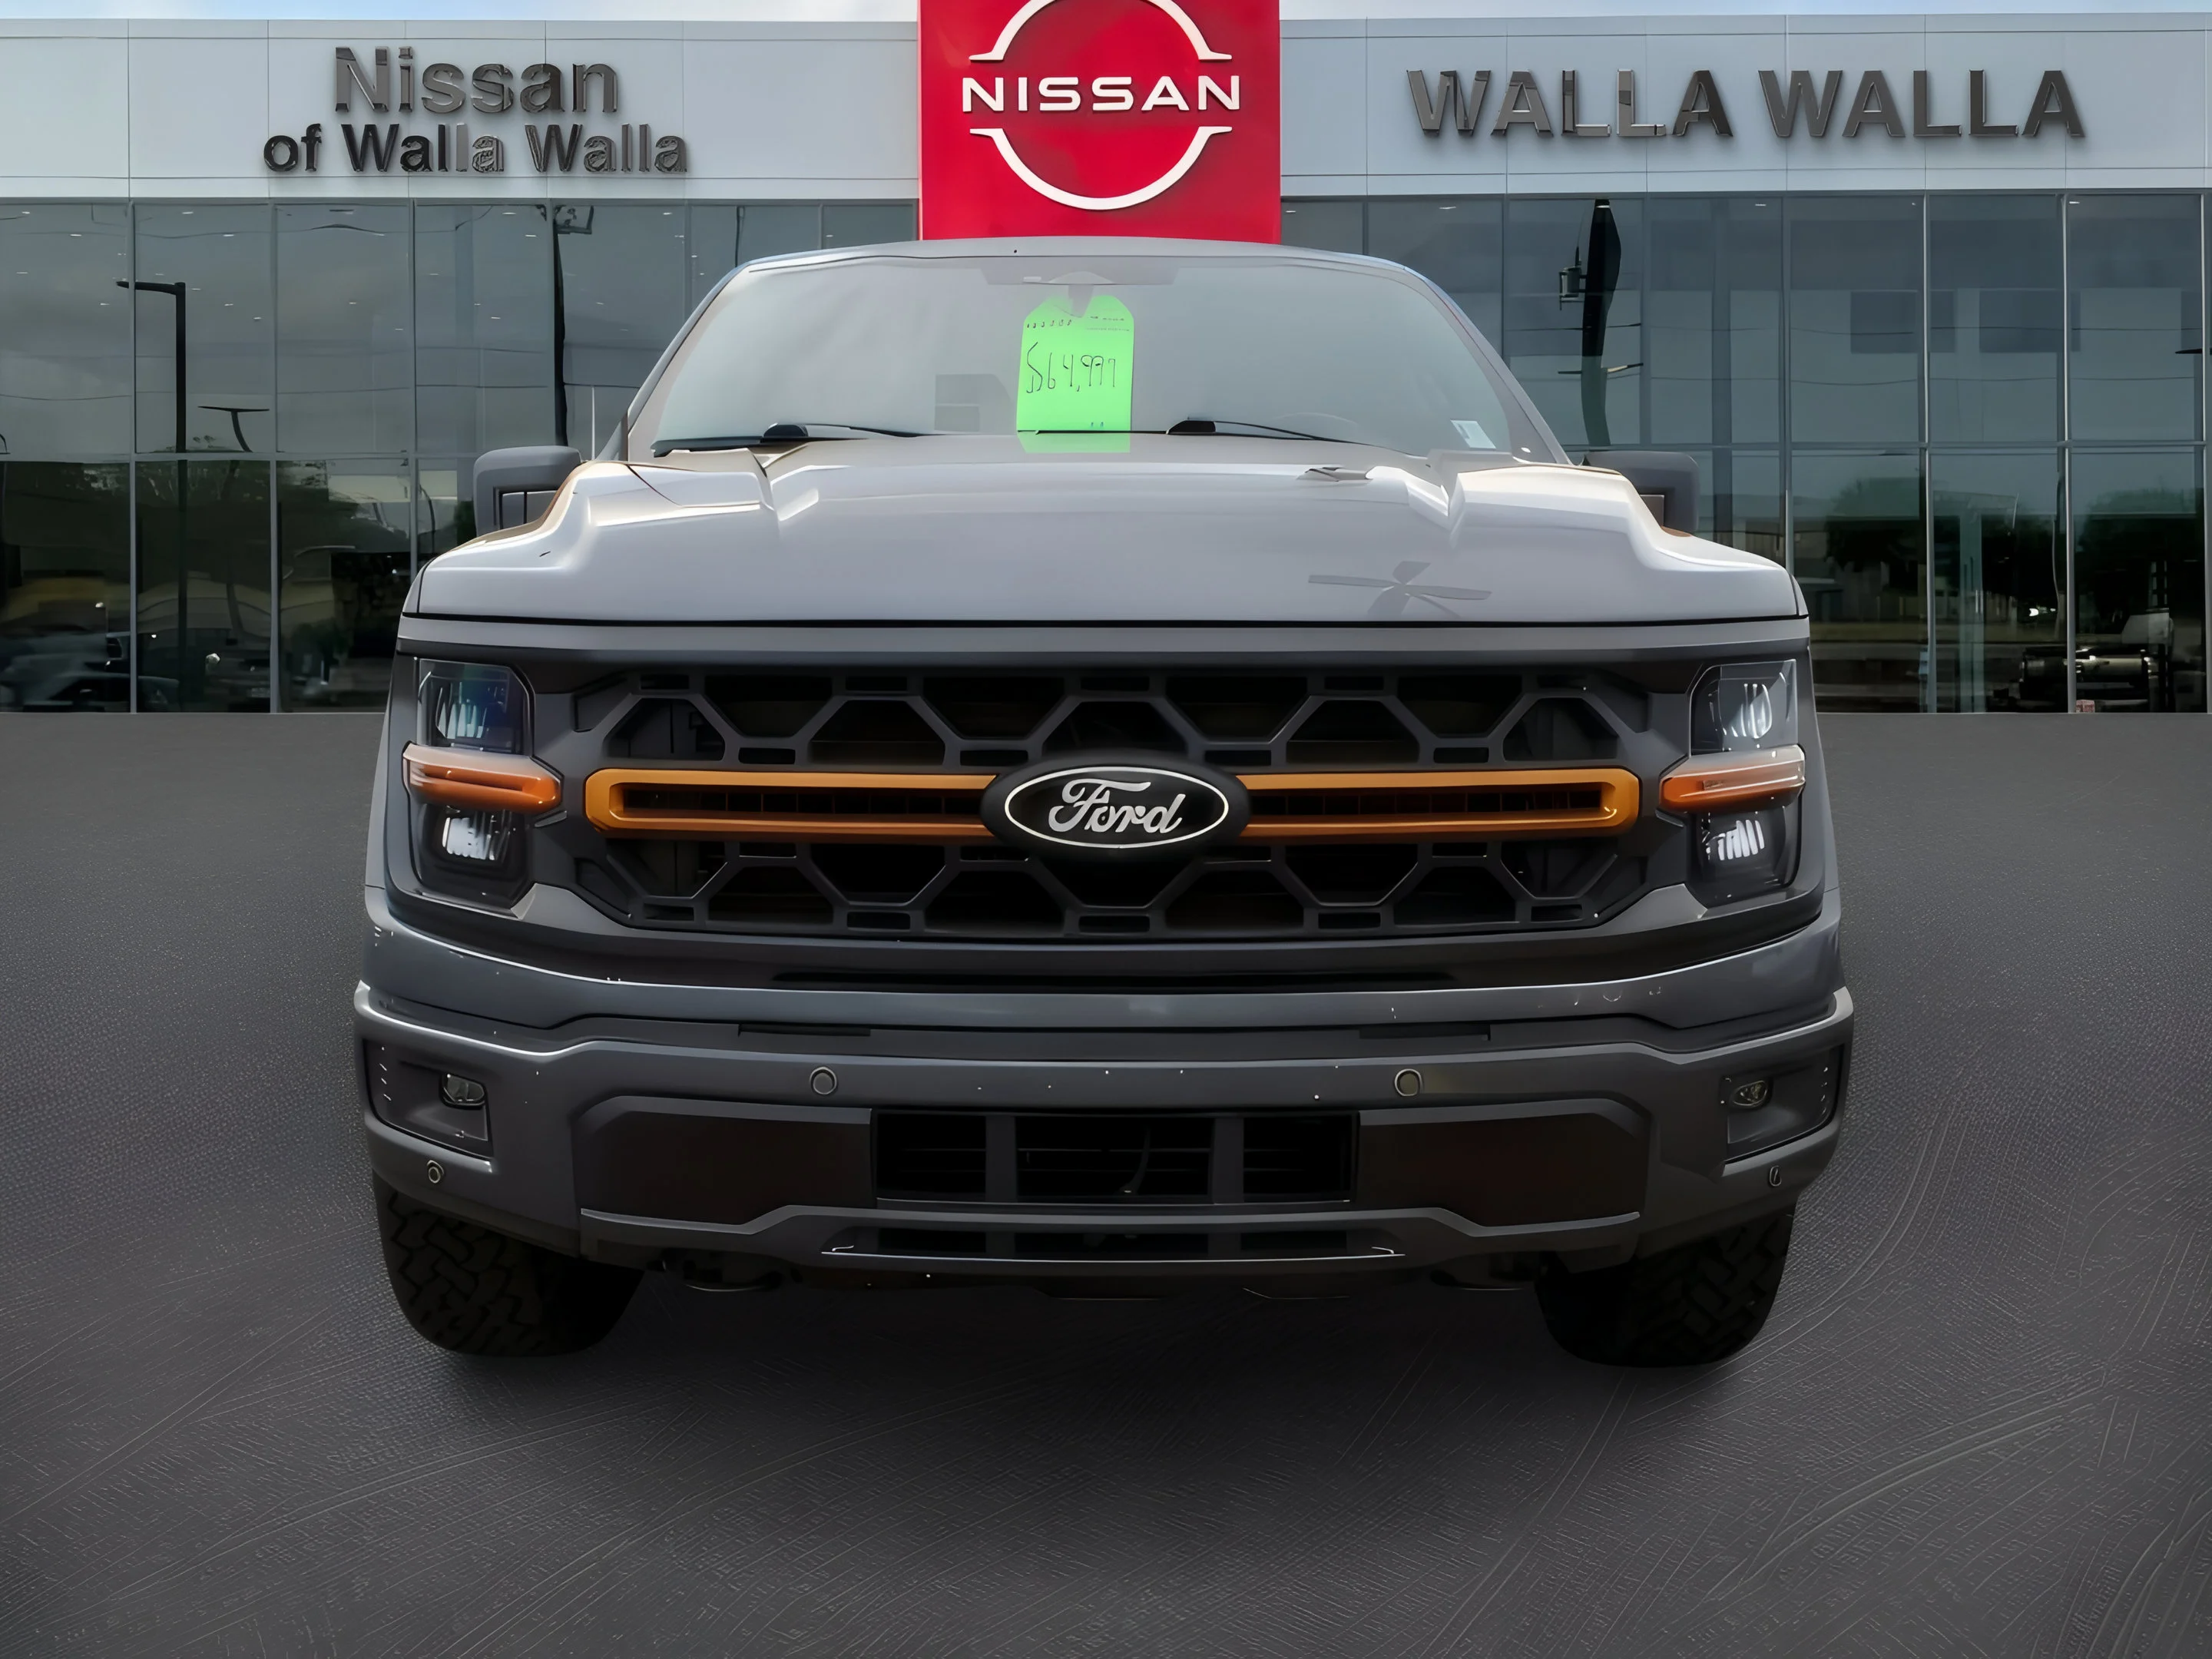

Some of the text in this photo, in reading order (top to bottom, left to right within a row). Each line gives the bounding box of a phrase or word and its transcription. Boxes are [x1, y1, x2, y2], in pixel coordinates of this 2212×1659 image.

[335, 46, 618, 113] Nissan
[962, 75, 1240, 112] NISSAN
[1406, 70, 2086, 138] WALLA WALLA
[263, 123, 688, 173] of Walla Walla
[1048, 778, 1186, 834] Ford
